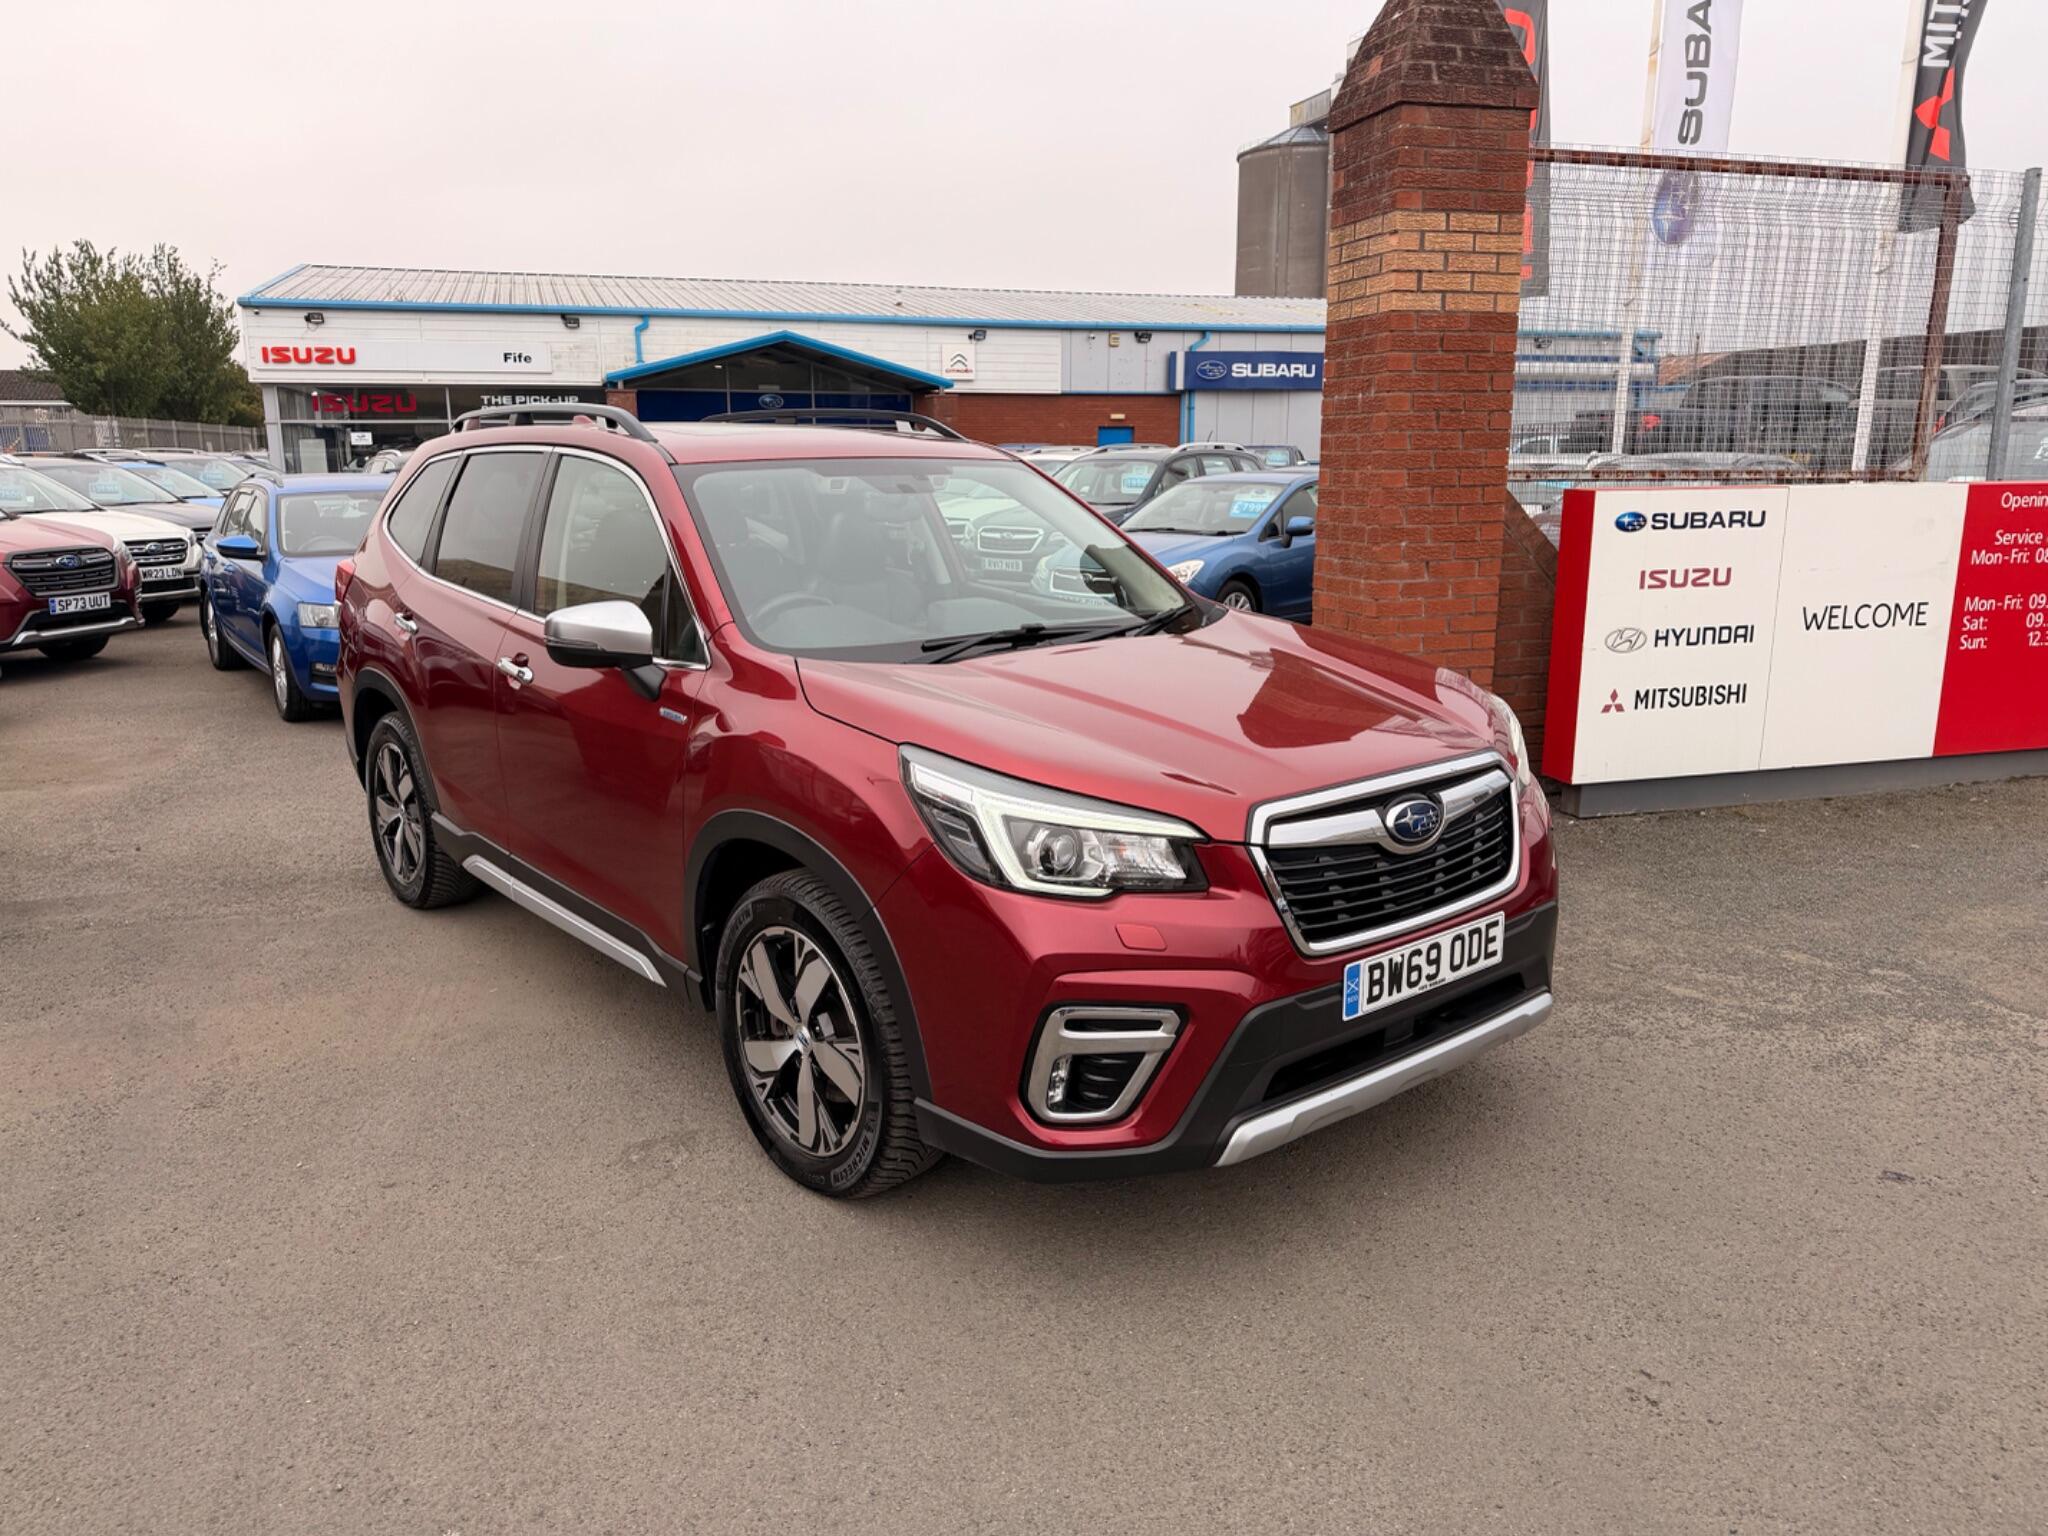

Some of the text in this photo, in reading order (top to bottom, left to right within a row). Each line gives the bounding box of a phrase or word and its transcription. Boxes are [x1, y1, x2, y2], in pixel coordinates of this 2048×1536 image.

[261, 347, 356, 365] ISUZU
[503, 352, 532, 364] Fife
[1231, 362, 1316, 378] SUBARU
[312, 391, 417, 413] ISUZU
[480, 395, 579, 405] THE PICK-UP
[1650, 510, 1766, 531] SUBARU
[1994, 528, 2043, 545] Service
[1639, 567, 1732, 590] ISUZU
[58, 594, 108, 612] SP73 UUT
[1802, 601, 1929, 631] WELCOME
[1961, 615, 1988, 631] Sat:
[1653, 624, 1754, 648] HYUNDAI
[1959, 634, 1988, 650] Sun:
[1634, 683, 1748, 710] MITSUBISHI
[1367, 919, 1500, 1005] BW69 ODE
